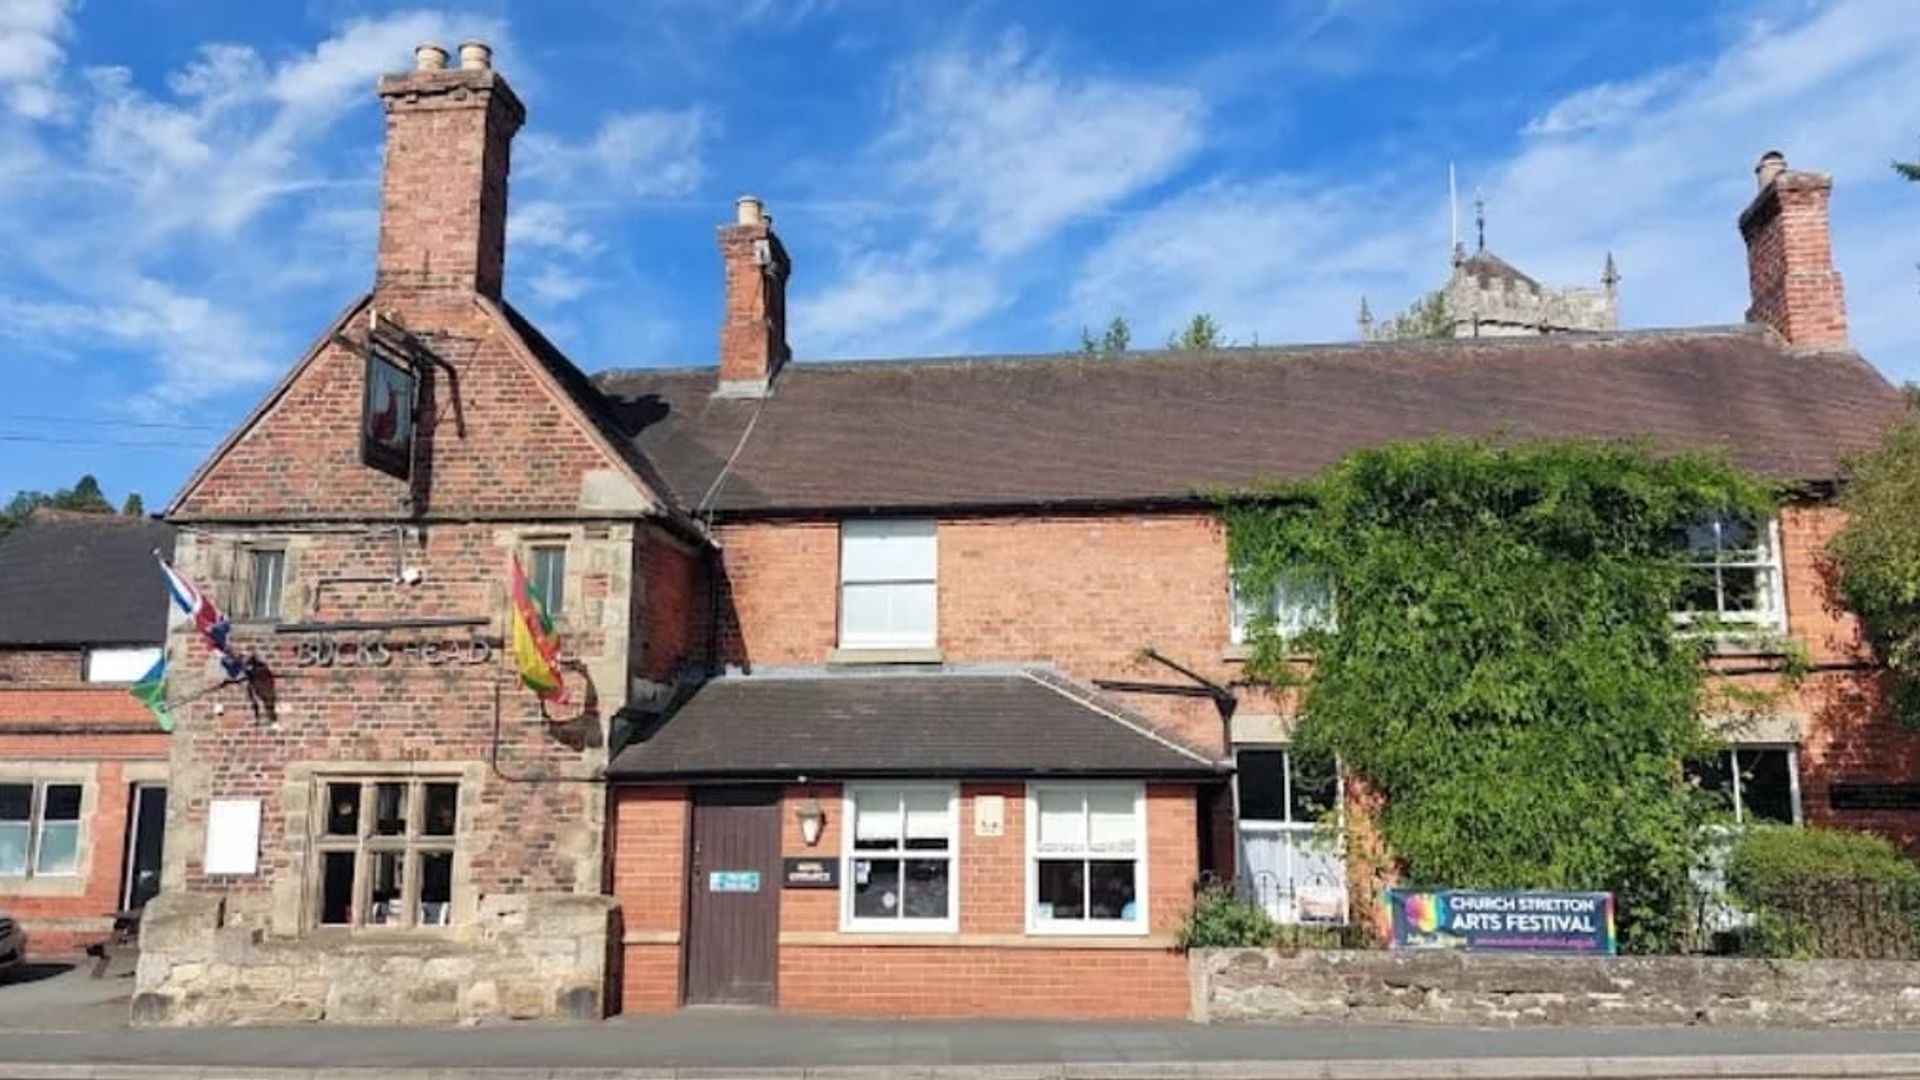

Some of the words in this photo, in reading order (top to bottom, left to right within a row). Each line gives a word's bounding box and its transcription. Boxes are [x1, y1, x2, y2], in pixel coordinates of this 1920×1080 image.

[299, 638, 392, 666] BUCKS
[1450, 897, 1515, 911] CHURCH
[1519, 899, 1595, 912] STRETTON
[1452, 913, 1502, 930] ARTS
[1506, 914, 1596, 932] FESTIVAL
